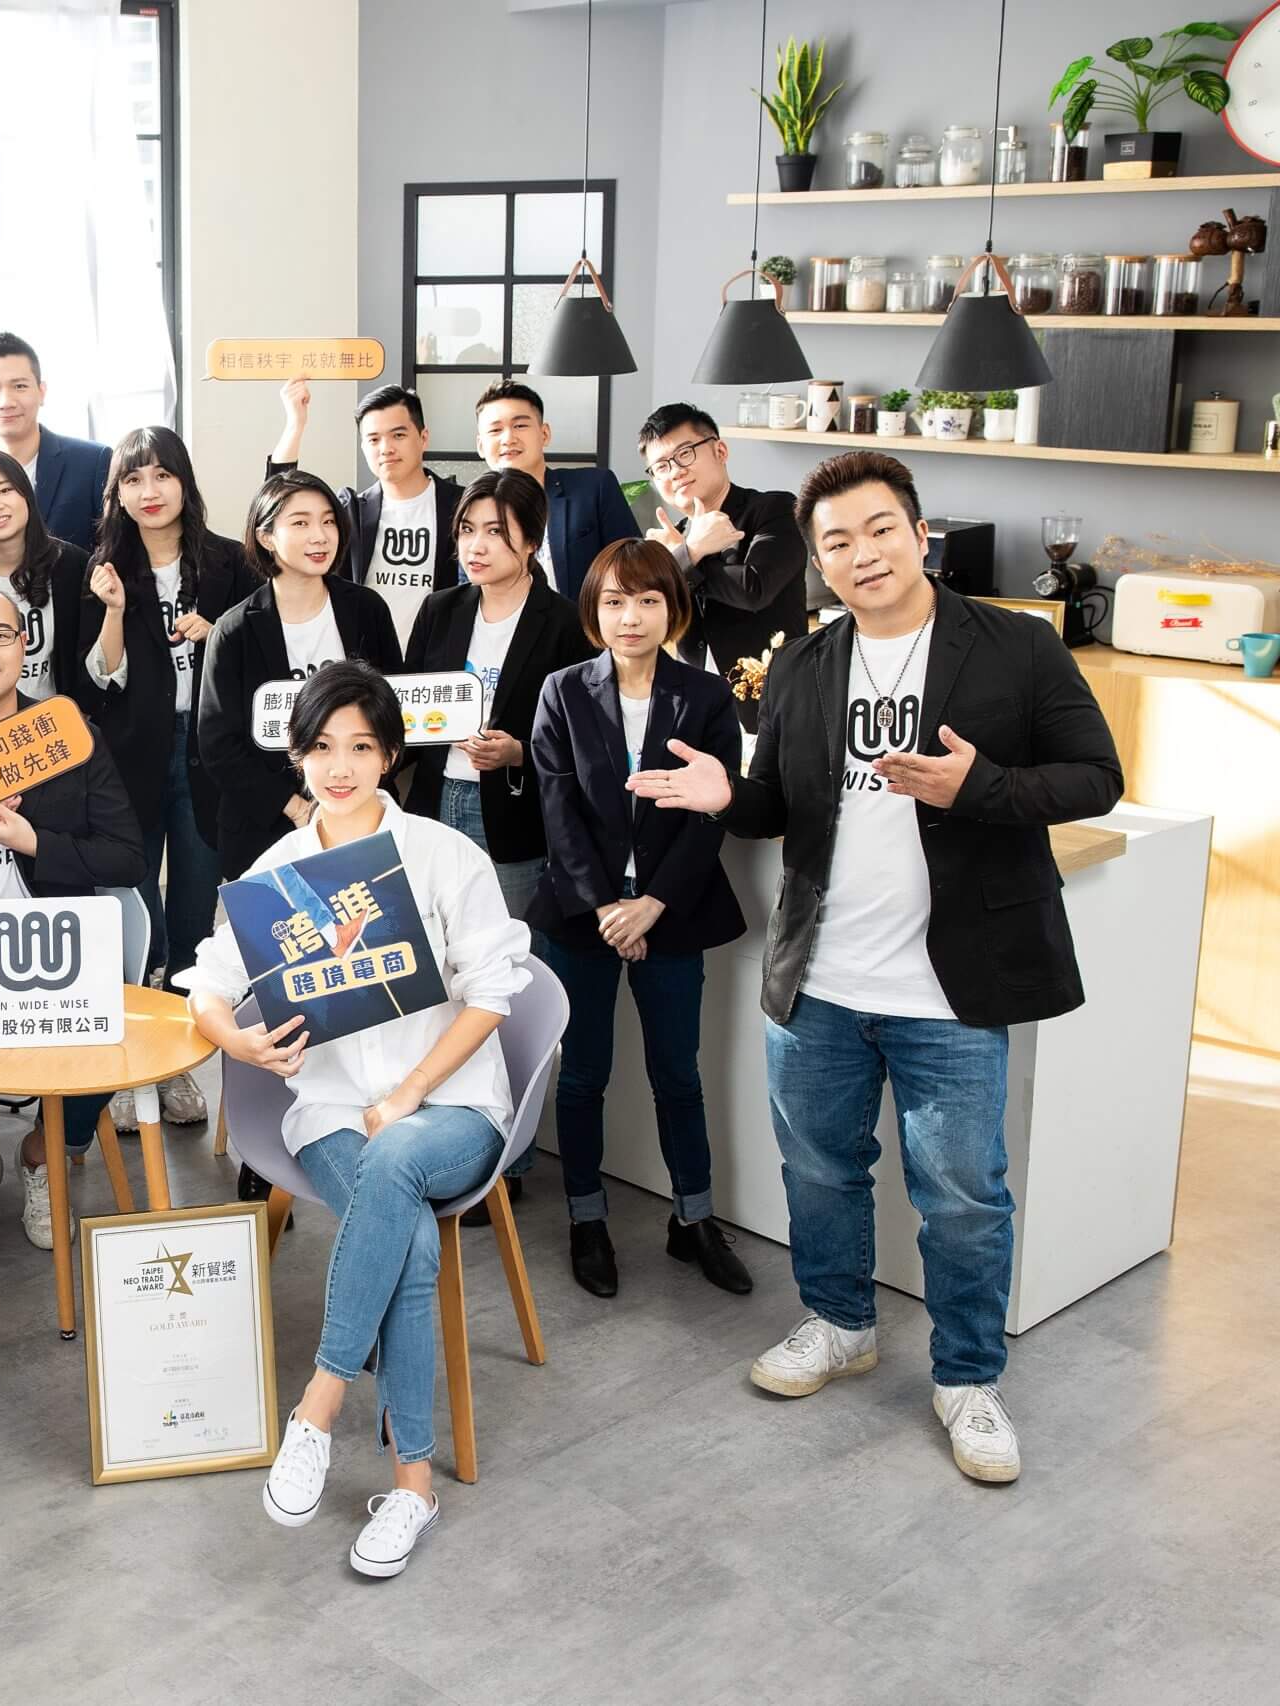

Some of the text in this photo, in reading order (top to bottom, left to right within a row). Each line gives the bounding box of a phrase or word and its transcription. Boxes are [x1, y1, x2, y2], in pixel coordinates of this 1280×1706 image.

[219, 352, 375, 369] 相信秩宇 成就無比
[375, 571, 433, 588] WISER
[291, 950, 407, 998] 跨境電商
[18, 1000, 49, 1011] WIDE
[60, 999, 90, 1010] WISE
[142, 1266, 164, 1276] TAIPEI
[191, 1260, 237, 1279] 新貿獎
[123, 1275, 164, 1286] NEO TRADE
[136, 1283, 165, 1292] AWARD
